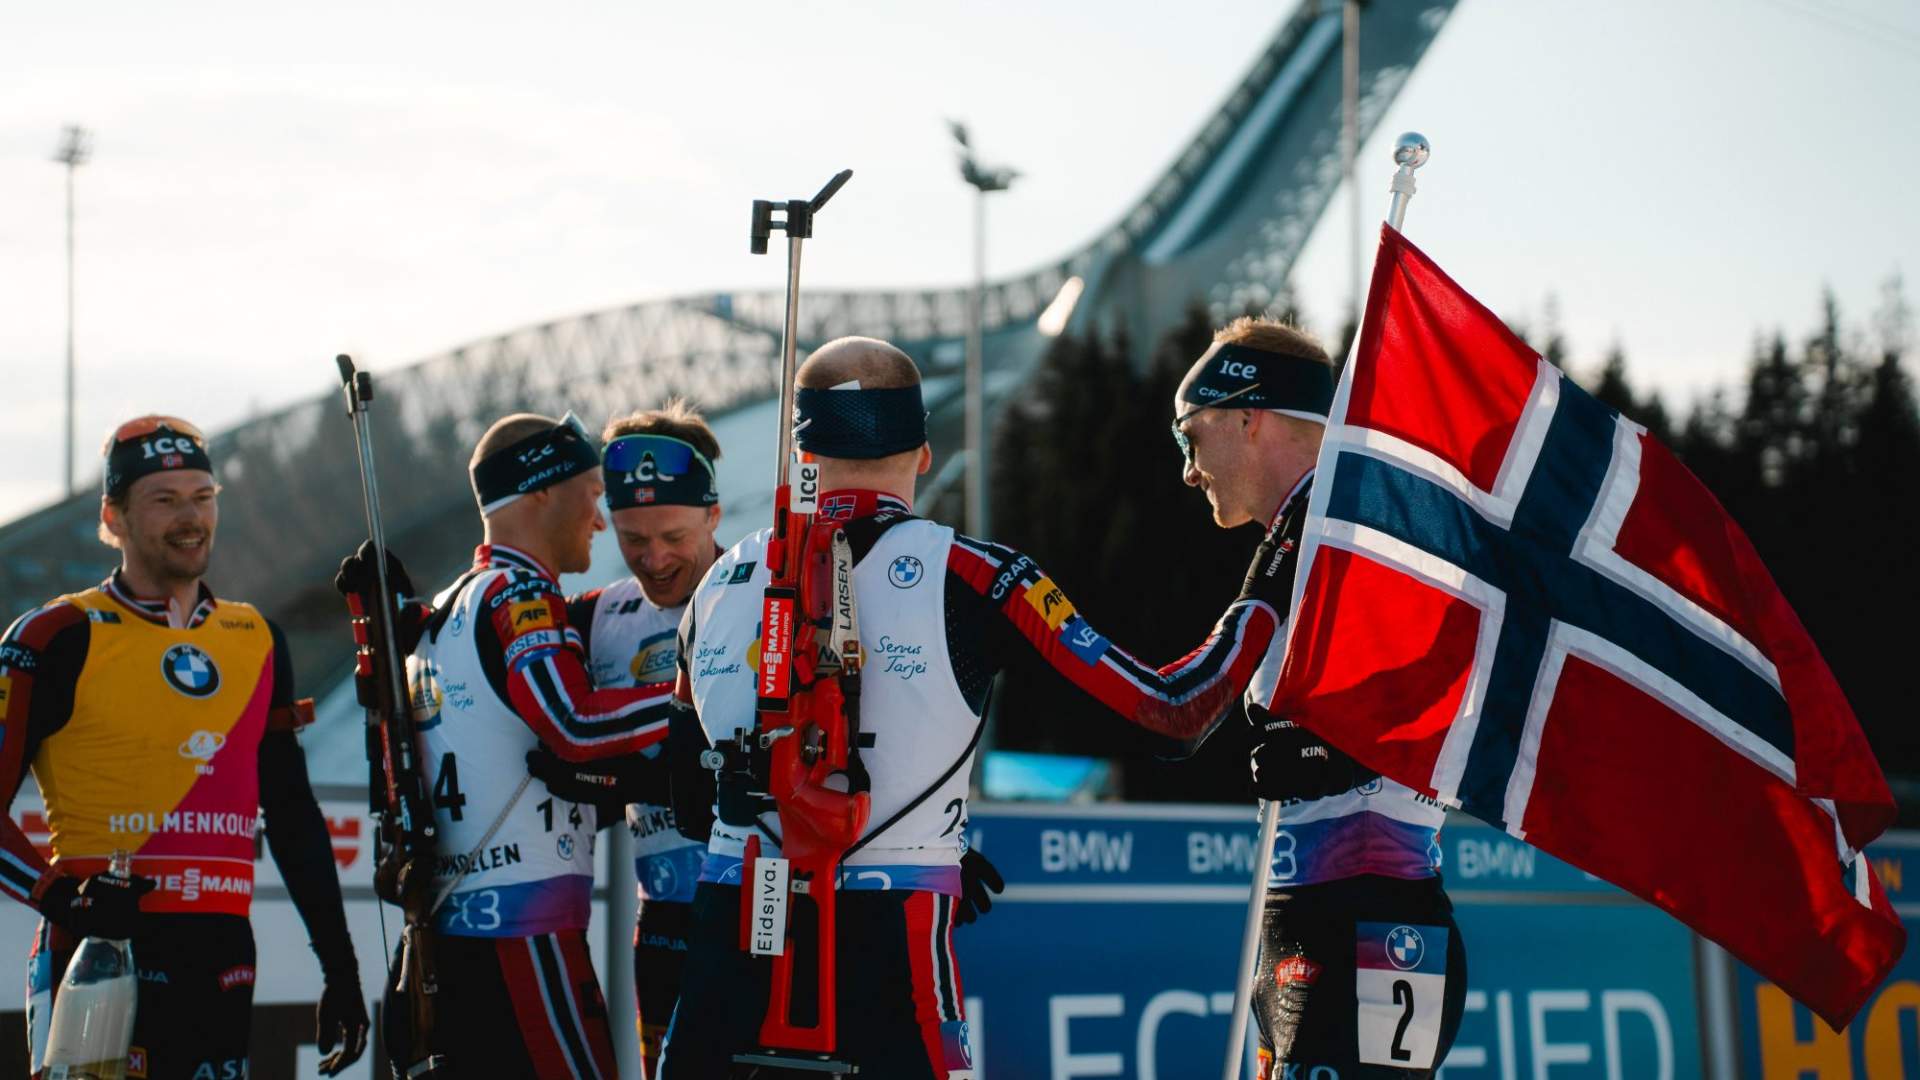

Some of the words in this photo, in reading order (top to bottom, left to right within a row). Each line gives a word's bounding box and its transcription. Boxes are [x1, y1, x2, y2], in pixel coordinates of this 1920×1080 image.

[490, 580, 548, 608] CRAFT
[839, 559, 852, 630] LARSEN
[991, 555, 1037, 600] CRAF
[874, 636, 922, 656] Servus
[884, 656, 928, 680] Tarjei
[1041, 831, 1133, 877] BMW
[1457, 838, 1537, 880] BMW
[1390, 979, 1416, 1062] 2
